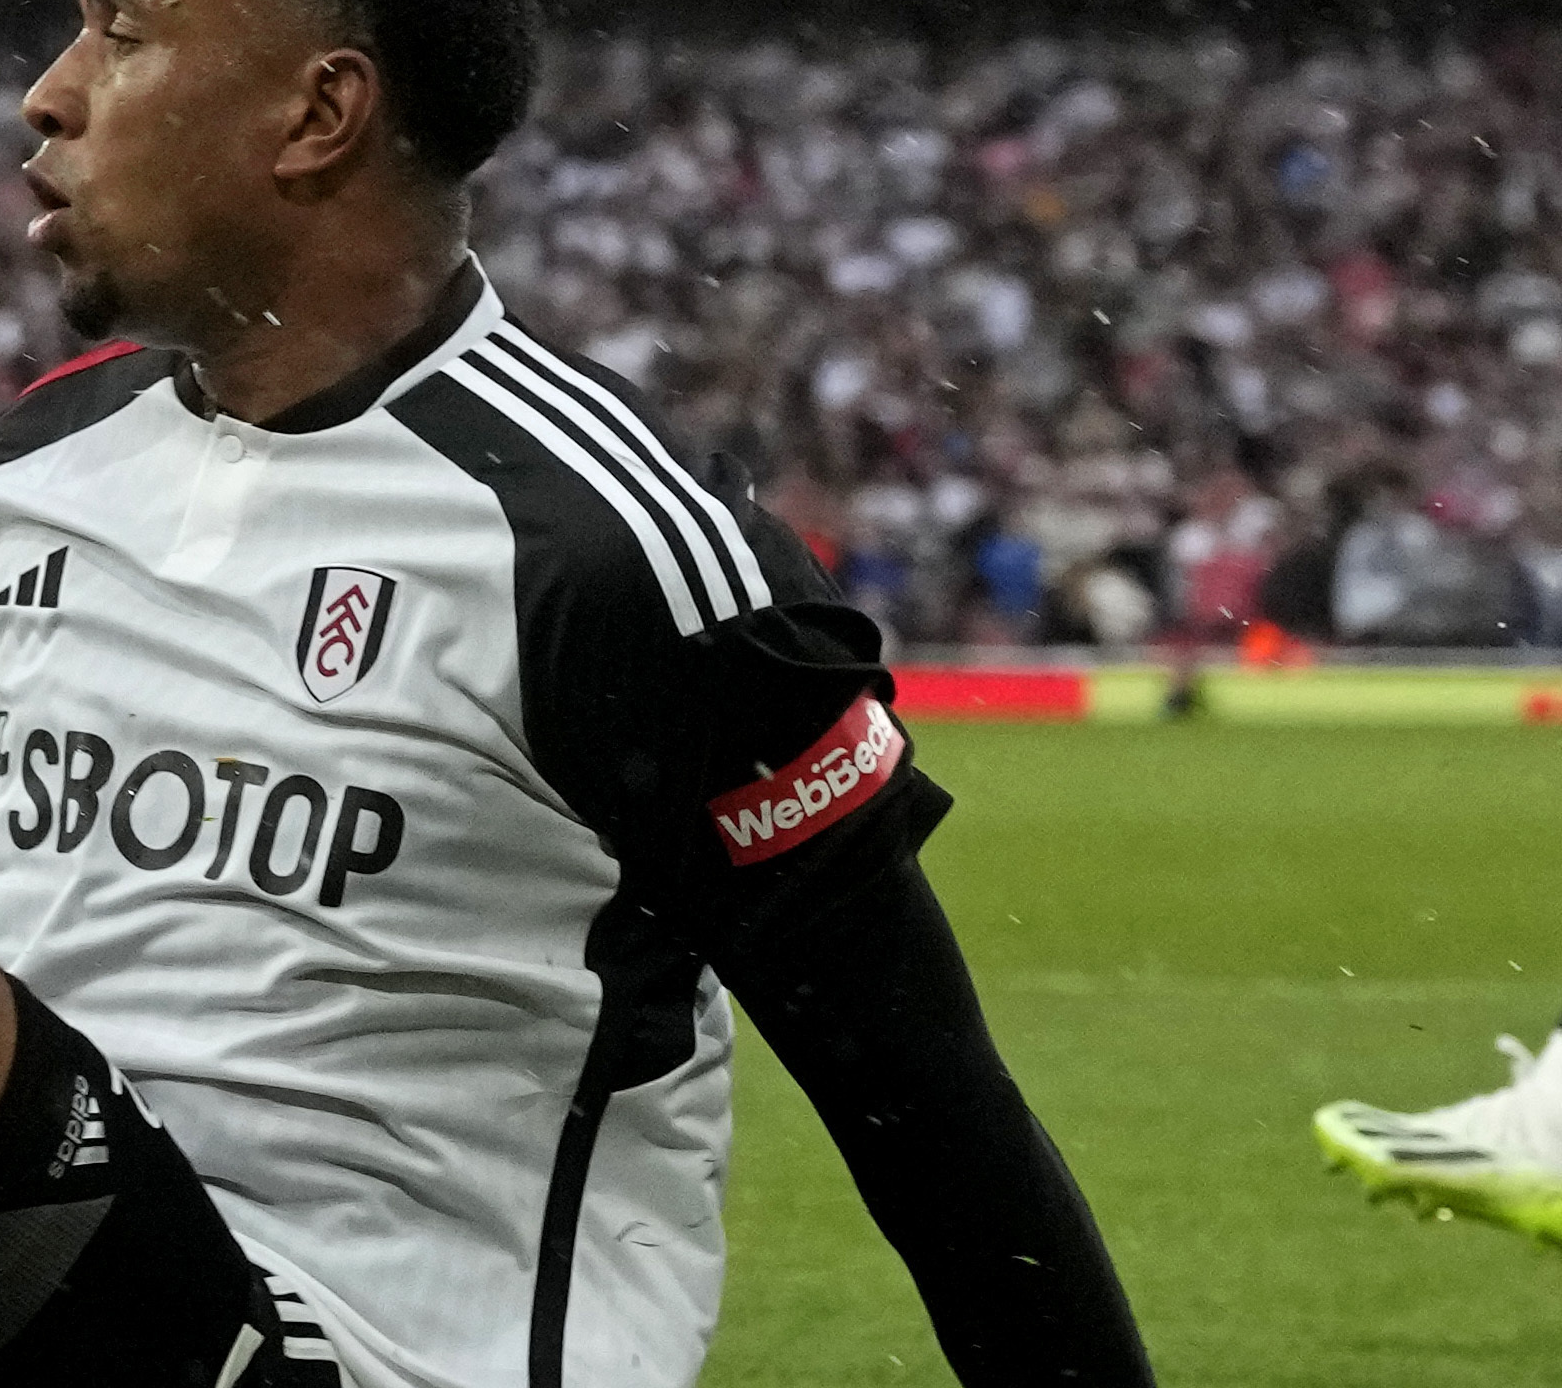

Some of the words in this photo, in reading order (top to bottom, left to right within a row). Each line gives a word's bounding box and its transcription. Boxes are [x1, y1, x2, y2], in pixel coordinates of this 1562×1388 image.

[316, 583, 370, 678] FFC
[8, 728, 405, 908] SBOTOP
[47, 1074, 91, 1179] adidas
